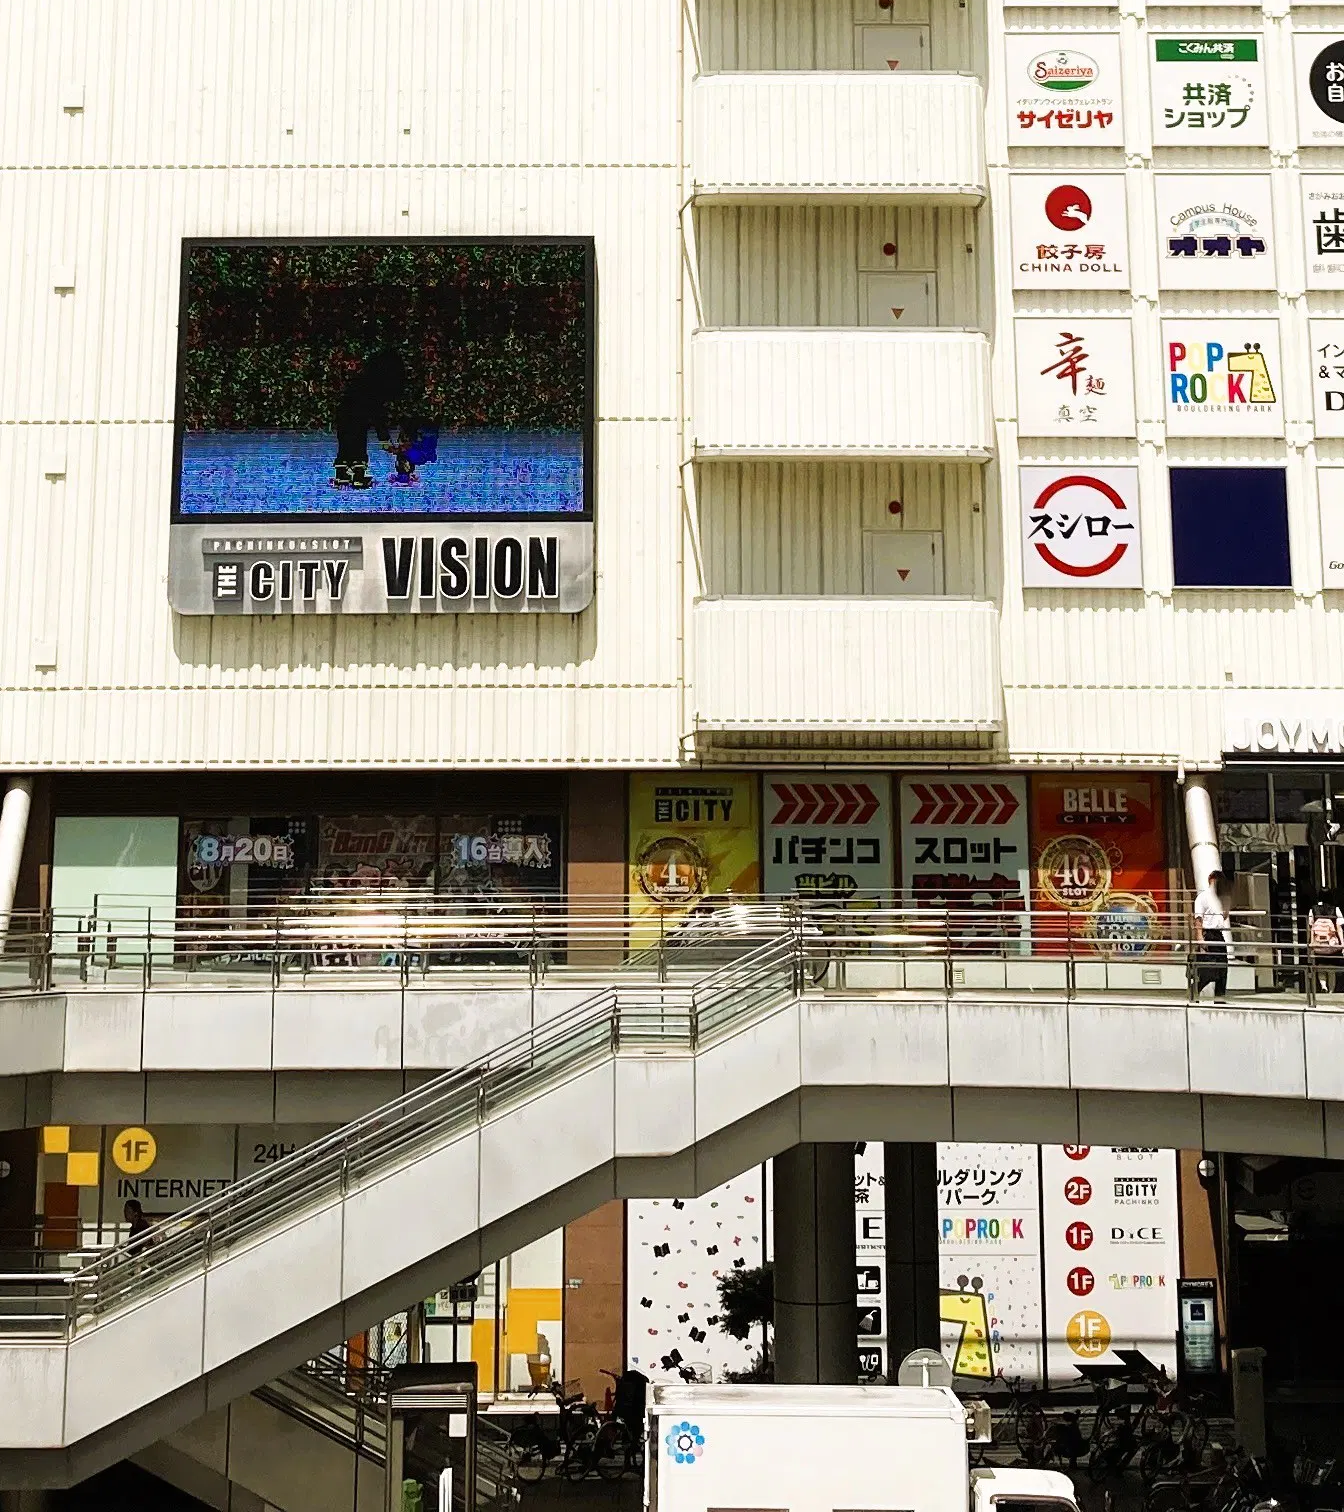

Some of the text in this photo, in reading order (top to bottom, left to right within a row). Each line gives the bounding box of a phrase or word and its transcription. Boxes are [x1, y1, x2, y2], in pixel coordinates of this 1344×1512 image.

[1178, 42, 1235, 56] こくみん共済
[1034, 61, 1094, 78] Saizeriya
[1182, 82, 1233, 106] 共済
[1016, 108, 1115, 130] サイゼリヤ
[1163, 104, 1252, 130] ショップ
[1169, 202, 1258, 228] Campus House
[1035, 243, 1106, 261] 餃子房
[1019, 263, 1124, 274] CHINA DOLL
[1168, 340, 1225, 374] POP
[1170, 372, 1247, 405] ROCK
[1026, 511, 1136, 541] スシロー
[381, 535, 560, 600] VISION
[217, 559, 350, 601] THE CITY
[658, 798, 733, 823] THE CITY
[1062, 788, 1130, 813] BELLE
[1063, 814, 1129, 824] CITY
[199, 837, 288, 862] 8月20日
[457, 837, 546, 862] 16台導入
[772, 835, 881, 865] パチンコ
[914, 837, 1018, 865] スロット
[120, 1140, 150, 1163] 1F
[945, 1187, 996, 1206] パーク
[1067, 1181, 1091, 1200] 2F
[1125, 1183, 1158, 1197] CITY
[1069, 1226, 1092, 1245] 1F
[1070, 1271, 1093, 1291] 1F
[1073, 1313, 1102, 1338] 1F
[1076, 1338, 1102, 1353] 入口
